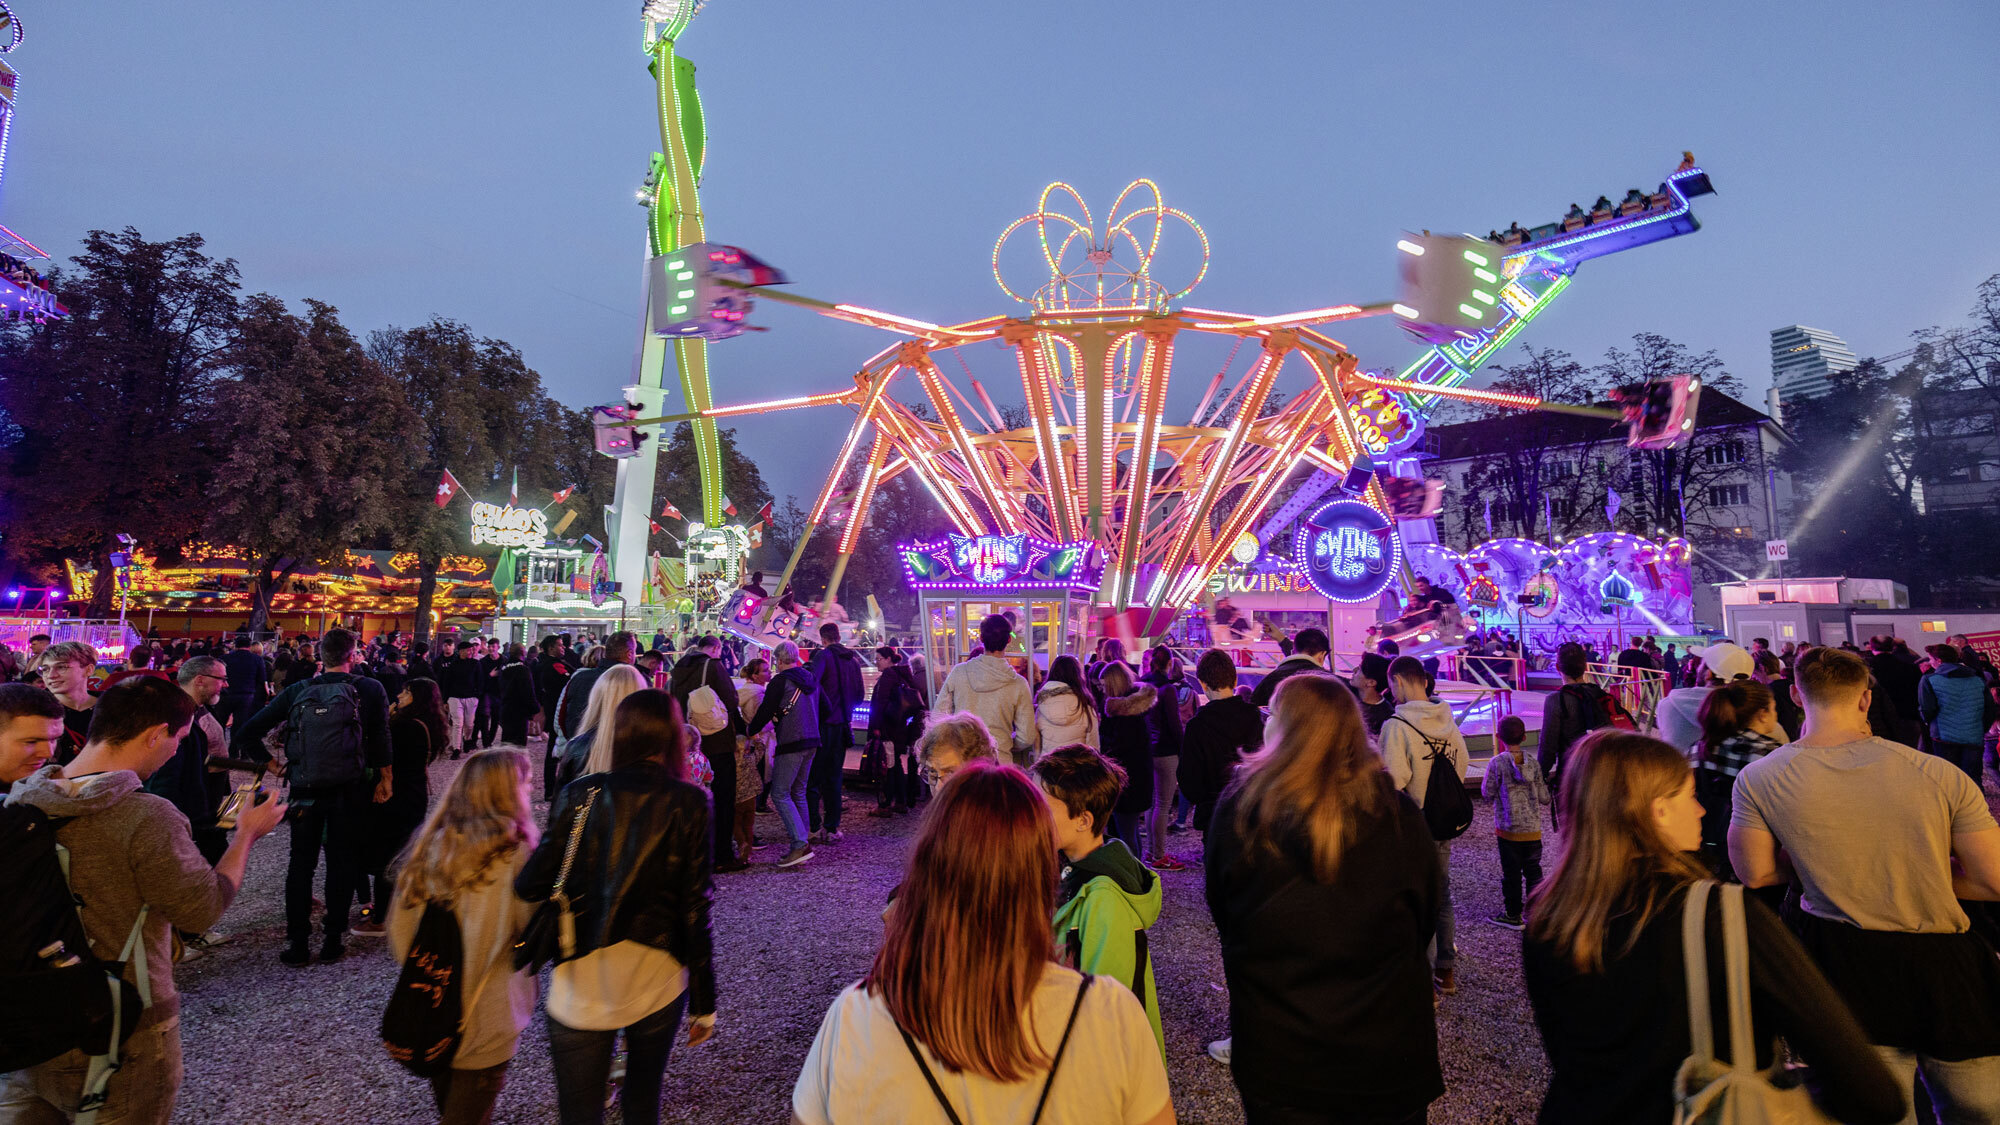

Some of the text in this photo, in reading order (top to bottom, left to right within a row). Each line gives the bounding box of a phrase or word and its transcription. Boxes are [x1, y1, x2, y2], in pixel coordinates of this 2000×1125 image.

[471, 502, 548, 537] CHAOS
[957, 537, 1019, 566] SWING
[1315, 527, 1381, 558] SWING
[1768, 544, 1786, 556] WC
